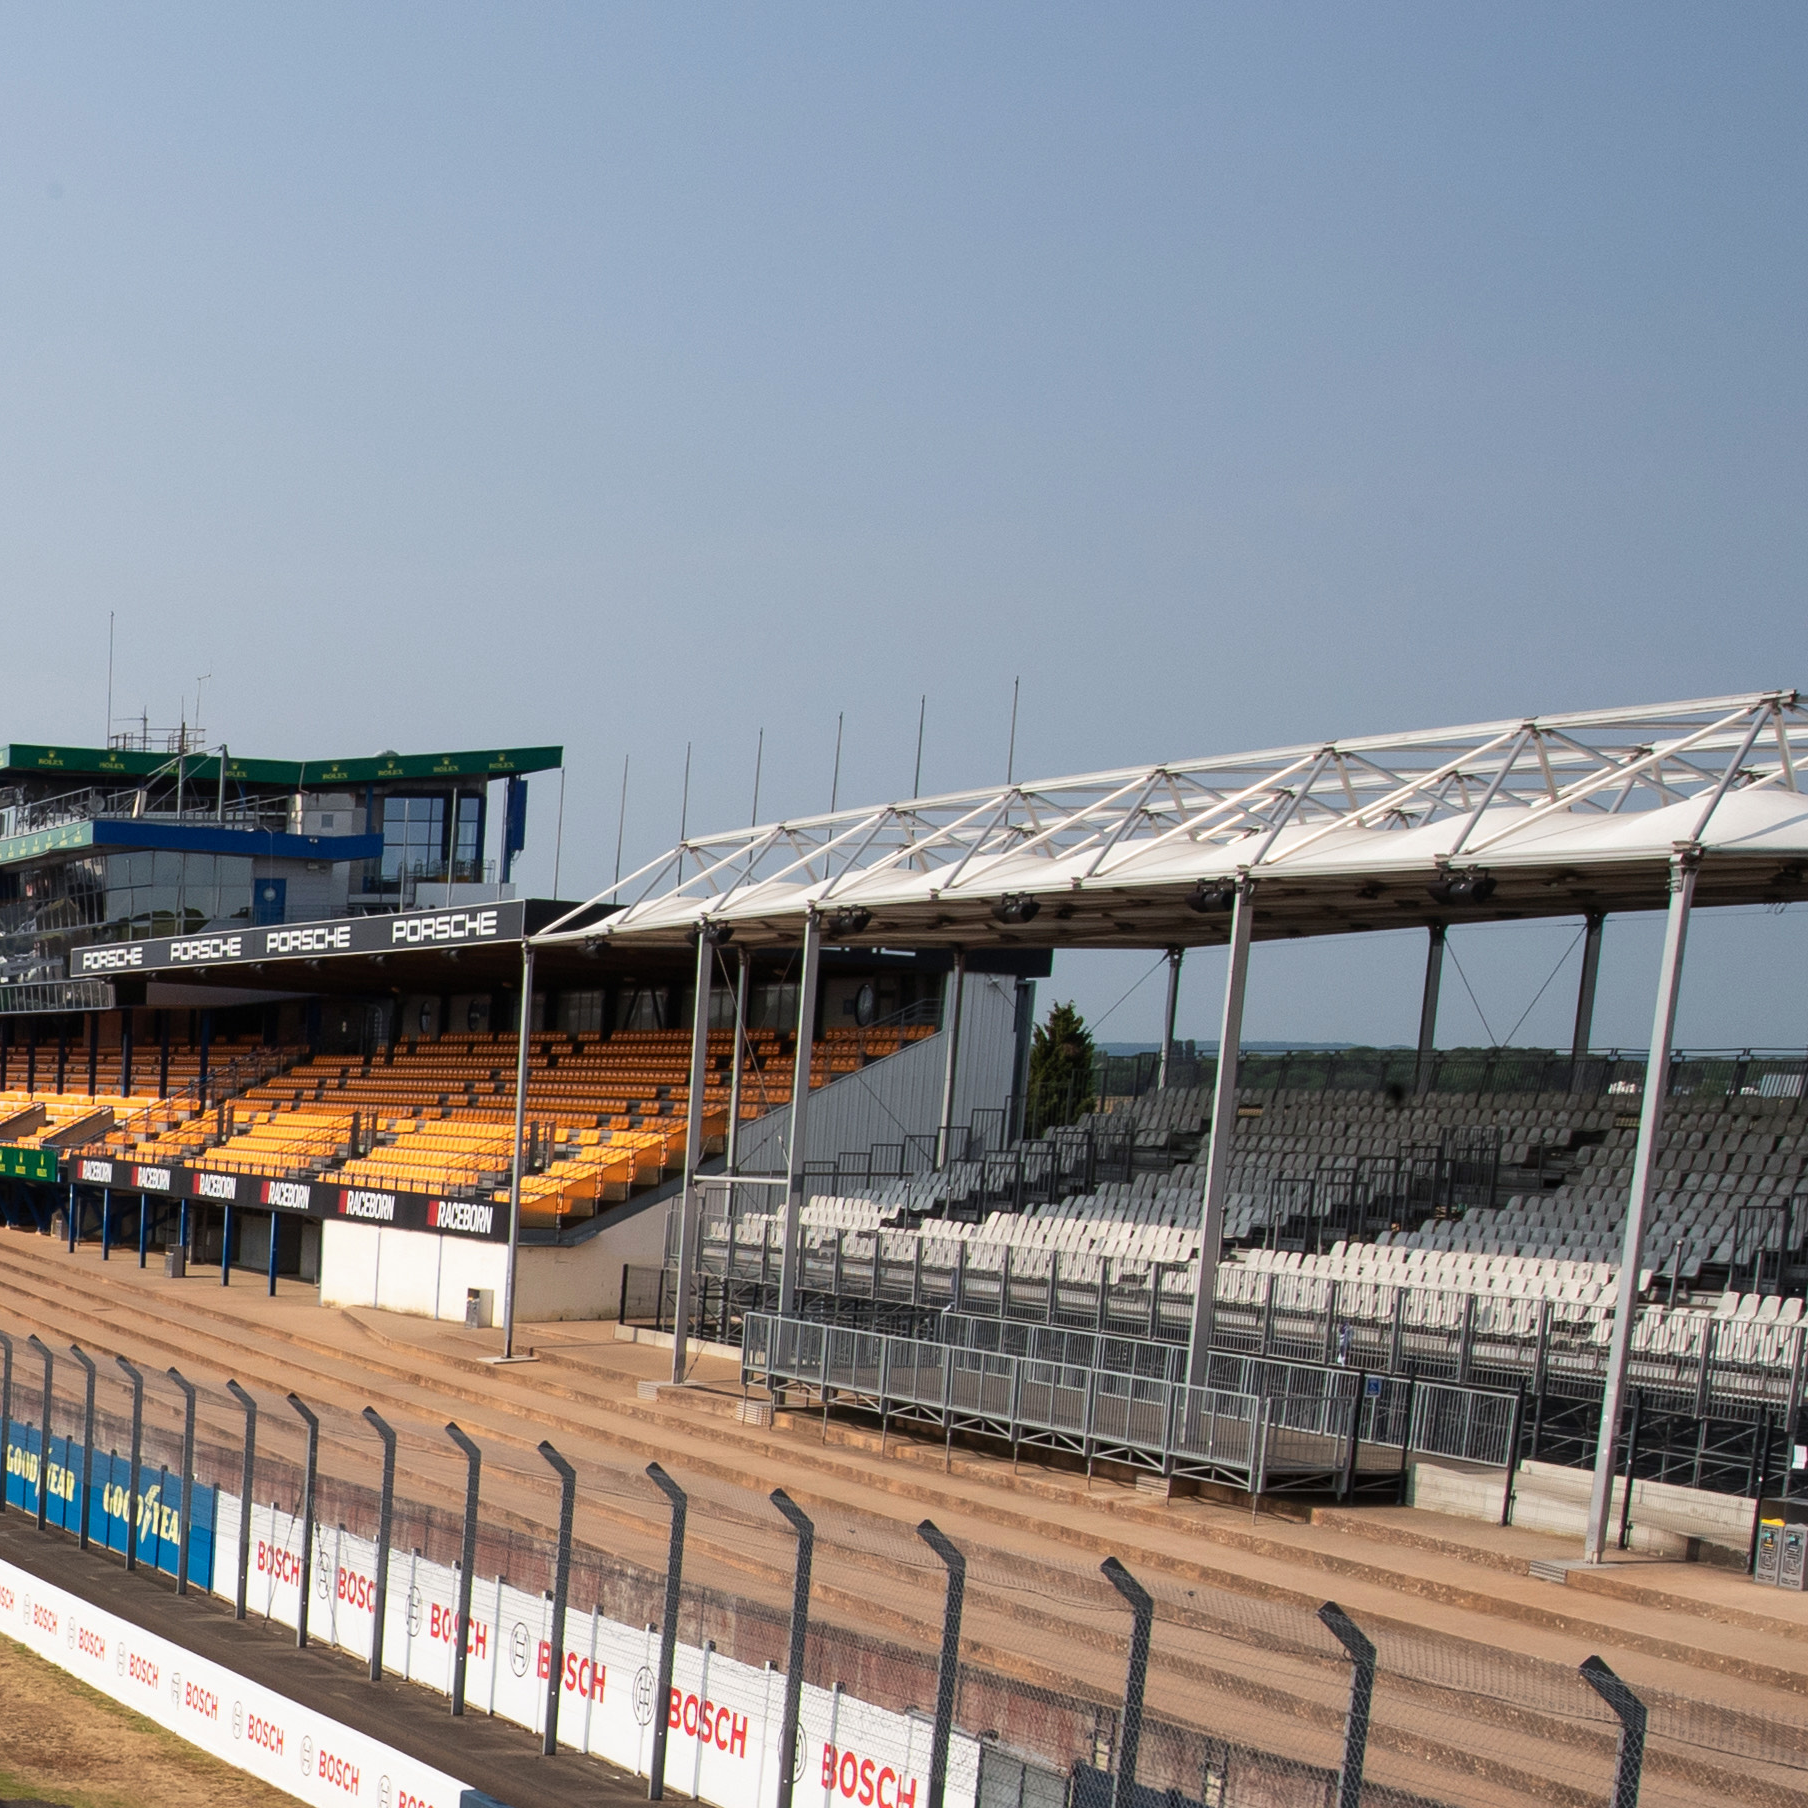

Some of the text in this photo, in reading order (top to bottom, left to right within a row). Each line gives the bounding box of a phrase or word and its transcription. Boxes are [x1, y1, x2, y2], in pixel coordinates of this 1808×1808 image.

[98, 760, 126, 770] ROLEX
[321, 771, 349, 781] ROLEX
[377, 767, 404, 777] ROLEX
[432, 764, 459, 773] ROLEX
[487, 761, 515, 770] ROLEX
[266, 927, 352, 953] PORSCHE
[391, 910, 498, 943] PORSCHE
[82, 946, 143, 969] PORSCHE
[170, 936, 242, 960] PORSCHE
[82, 1161, 112, 1183] RACEBORN
[137, 1167, 170, 1191] RACEBORN
[199, 1174, 236, 1199] RACEBORN
[268, 1181, 310, 1210] RACEBORN
[346, 1190, 395, 1221] RACEBORN
[437, 1201, 494, 1234] RACEBORN
[258, 1541, 300, 1587] BOSCH
[32, 1603, 58, 1636] BOSCH
[78, 1626, 106, 1662] BOSCH
[128, 1651, 159, 1690] BOSCH
[185, 1680, 219, 1721] BOSCH
[247, 1713, 285, 1757] BOSCH
[669, 1686, 748, 1758] BOSCH
[318, 1750, 361, 1797] BOSCH
